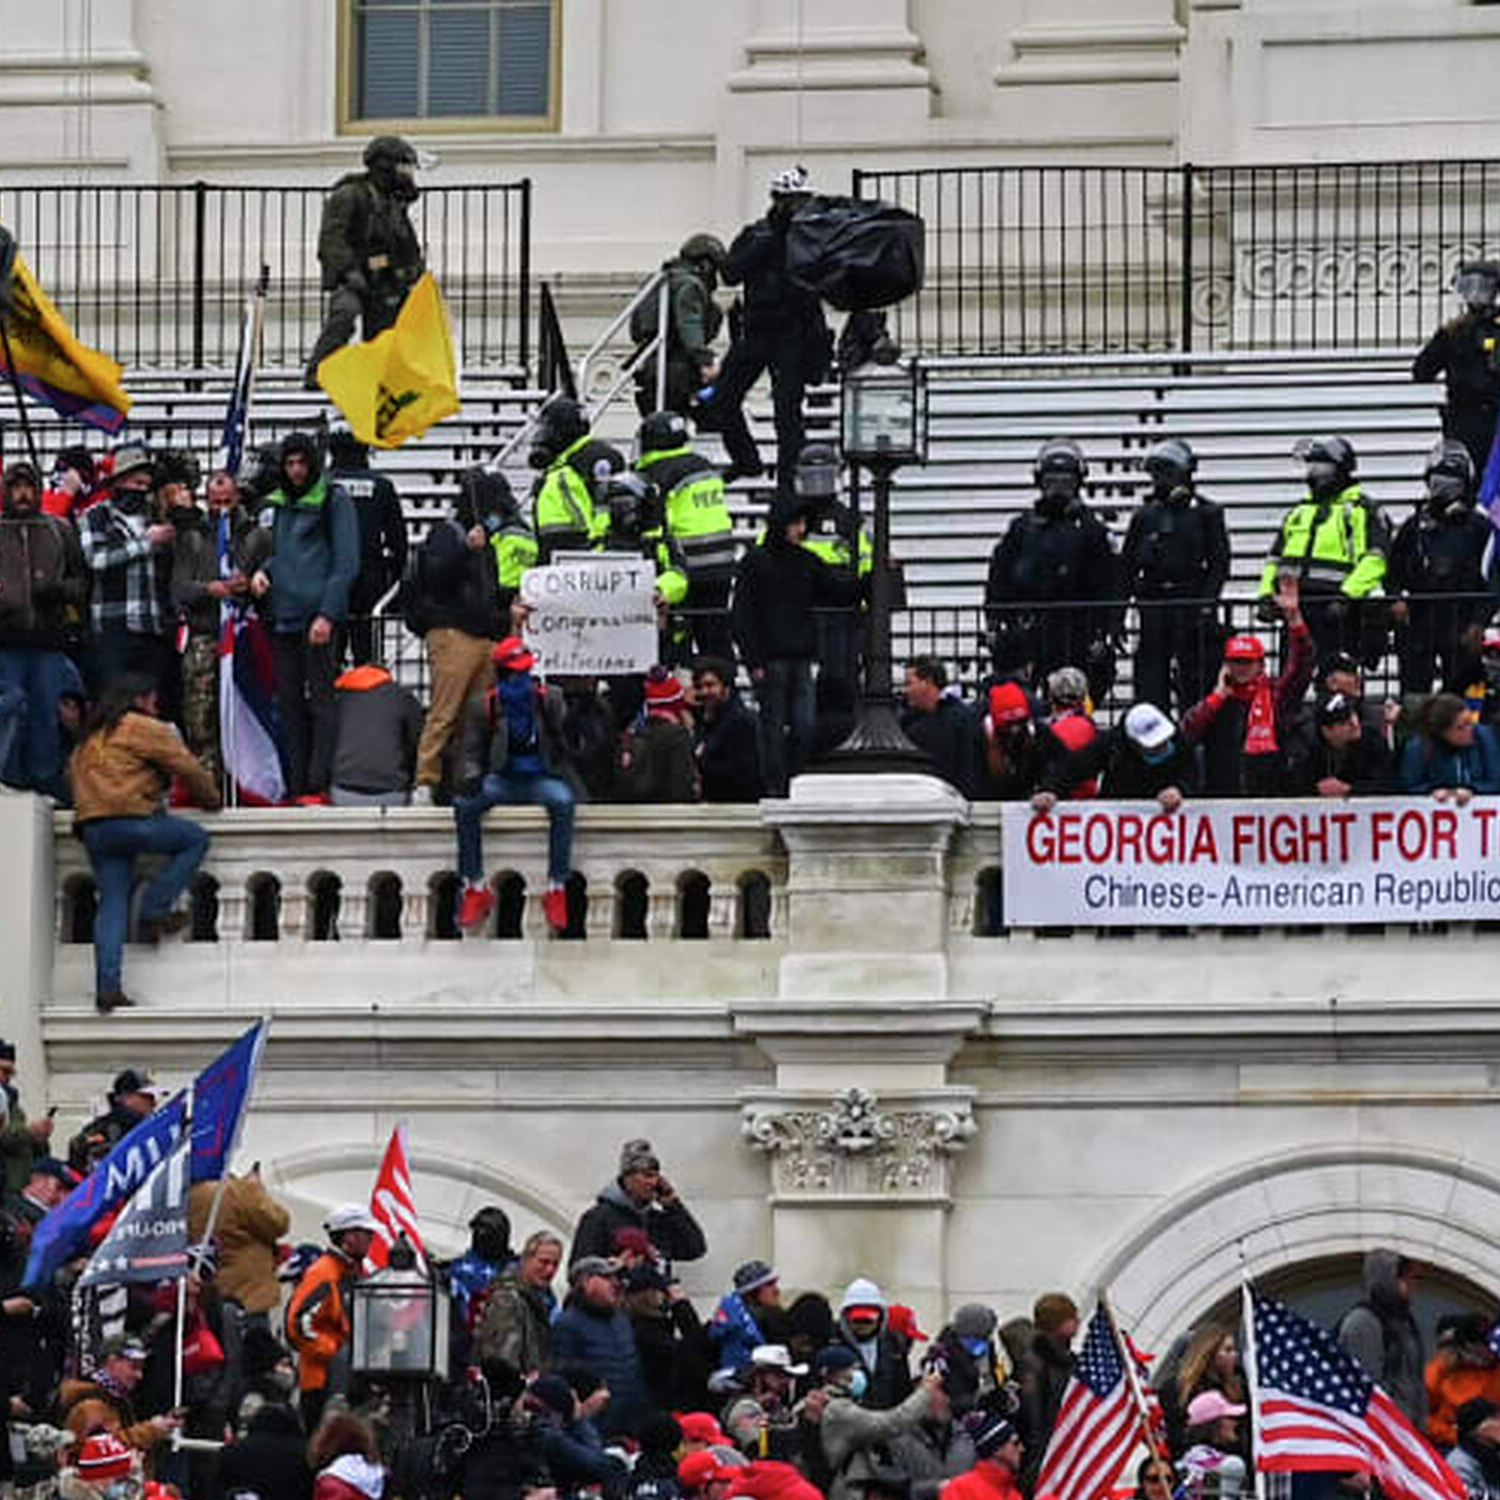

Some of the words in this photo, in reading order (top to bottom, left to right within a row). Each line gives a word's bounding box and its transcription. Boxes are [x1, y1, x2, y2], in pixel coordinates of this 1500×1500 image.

[1025, 813, 1219, 865] GEORGIA
[1232, 812, 1357, 865] FIGHT
[1370, 808, 1459, 862] FOR
[1083, 874, 1364, 910] Chinese-American
